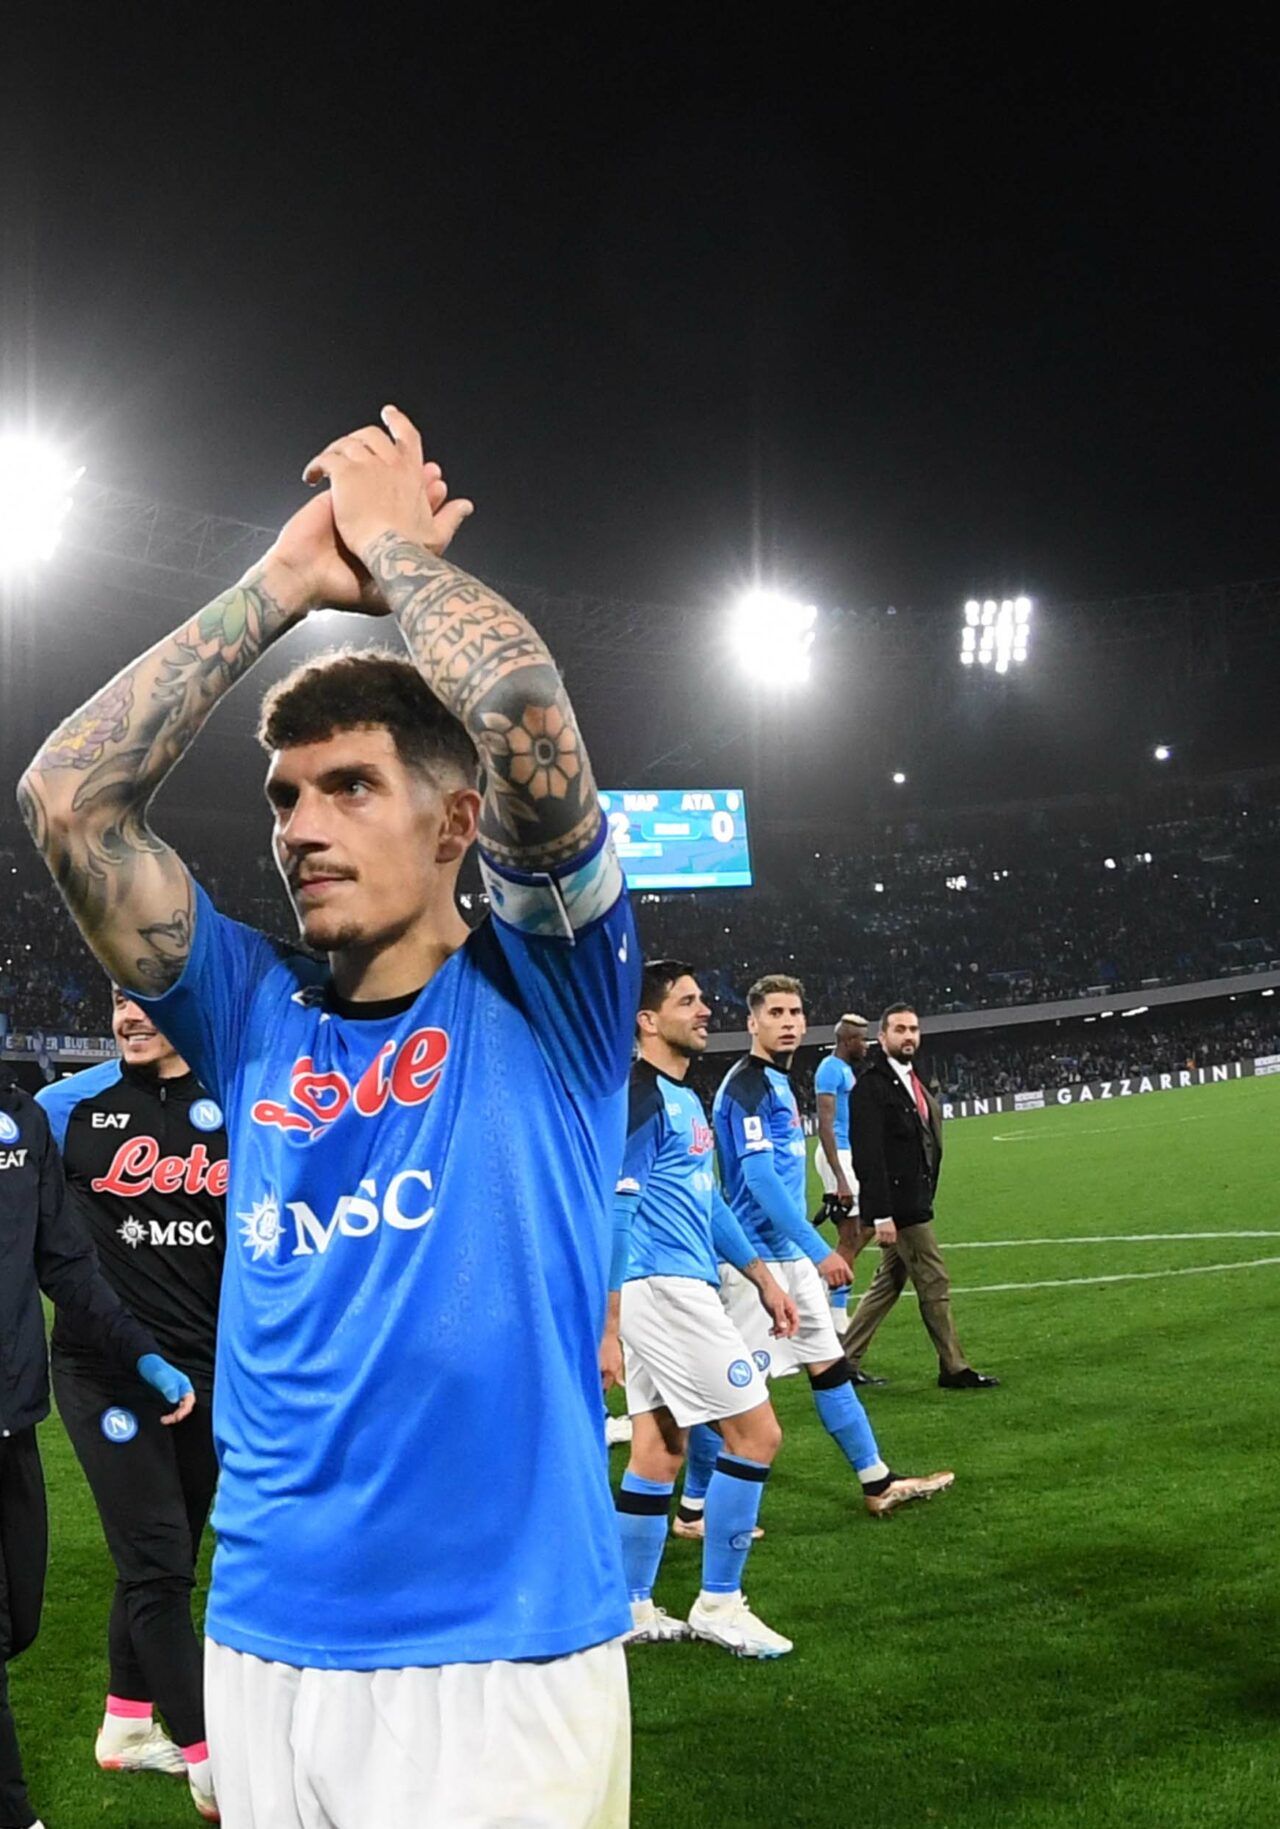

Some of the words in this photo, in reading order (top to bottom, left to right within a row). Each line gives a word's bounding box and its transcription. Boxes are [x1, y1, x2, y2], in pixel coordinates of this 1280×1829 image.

[623, 794, 658, 811] NAP
[681, 793, 715, 811] ATA
[609, 812, 631, 843] 2
[711, 811, 734, 843] 0
[1057, 1061, 1242, 1105] GAZZARRINI
[91, 1112, 131, 1129] EA7
[91, 1135, 229, 1197] Lete
[286, 1169, 436, 1256] MSC
[149, 1220, 215, 1246] MSC
